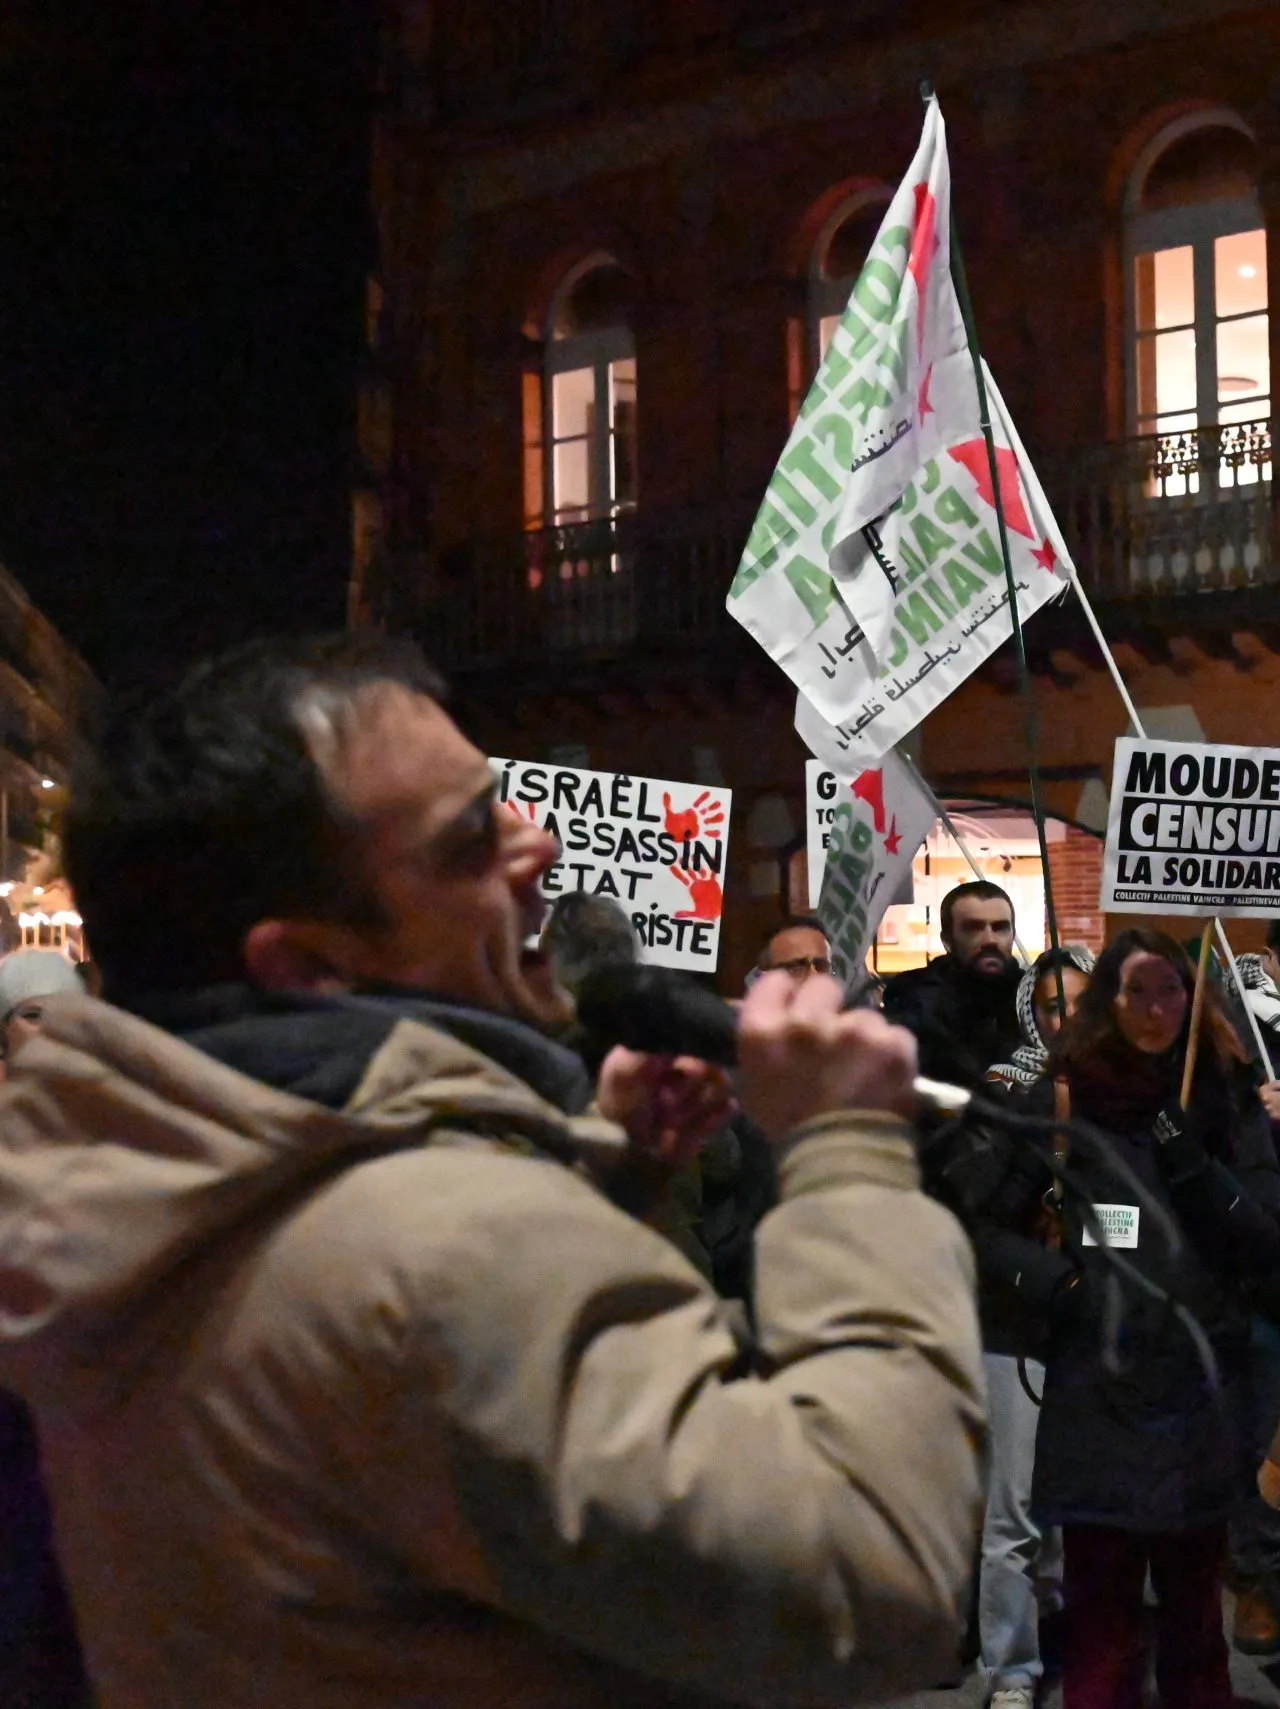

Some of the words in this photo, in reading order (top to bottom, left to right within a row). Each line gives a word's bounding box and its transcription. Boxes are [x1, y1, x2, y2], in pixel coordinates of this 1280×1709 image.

[1116, 855, 1151, 884] LA
[1115, 891, 1151, 900] COLLECTIF
[1153, 893, 1191, 903] PALESTINE
[1193, 895, 1225, 904] VAINCRA
